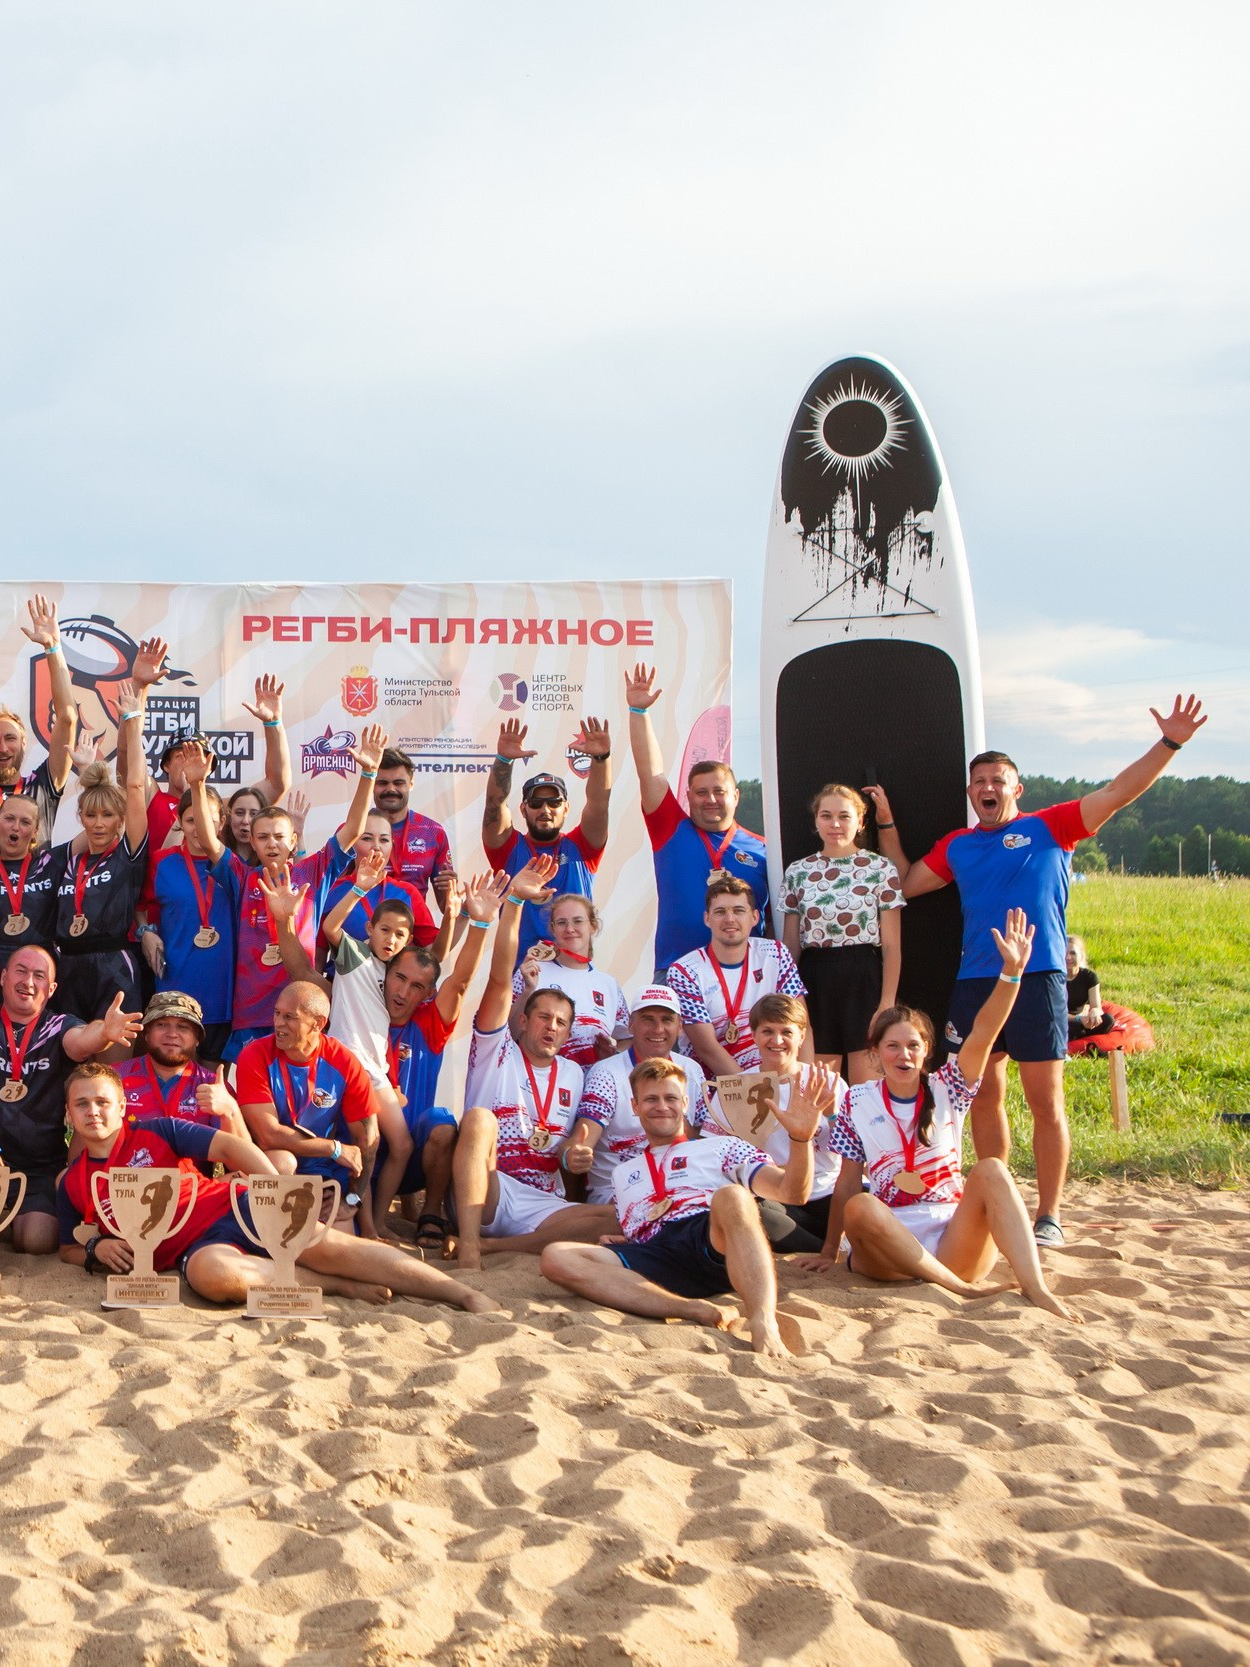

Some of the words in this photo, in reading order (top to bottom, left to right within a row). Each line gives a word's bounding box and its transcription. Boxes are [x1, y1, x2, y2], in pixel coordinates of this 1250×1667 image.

[242, 615, 653, 646] РЕГБИ-ПЛЯЖНОЕ
[384, 677, 453, 687] Министерство
[532, 674, 567, 684] ЦЕНТР
[384, 688, 416, 698] спорта
[419, 688, 461, 697] Тульской
[532, 684, 584, 693] ИГРОВЫХ
[384, 697, 423, 706] области
[532, 693, 570, 702] ВИДОВ
[532, 702, 574, 711] СПОРТА
[144, 712, 196, 732] ЕГБИ
[303, 754, 355, 772] АРМЕЙЦЫ
[413, 763, 494, 773] нтеллект
[10, 924, 16, 933] 2
[73, 924, 79, 934] 2
[531, 948, 540, 957] 3
[720, 1079, 743, 1088] РЕГБИ
[5, 1089, 12, 1099] 2
[723, 1093, 742, 1102] ТУЛА
[532, 1137, 540, 1147] 3
[113, 1173, 138, 1182] РЕГБИ
[253, 1180, 279, 1190] РЕГБИ
[115, 1189, 135, 1198] ТУЛА
[254, 1196, 276, 1206] ТУЛА
